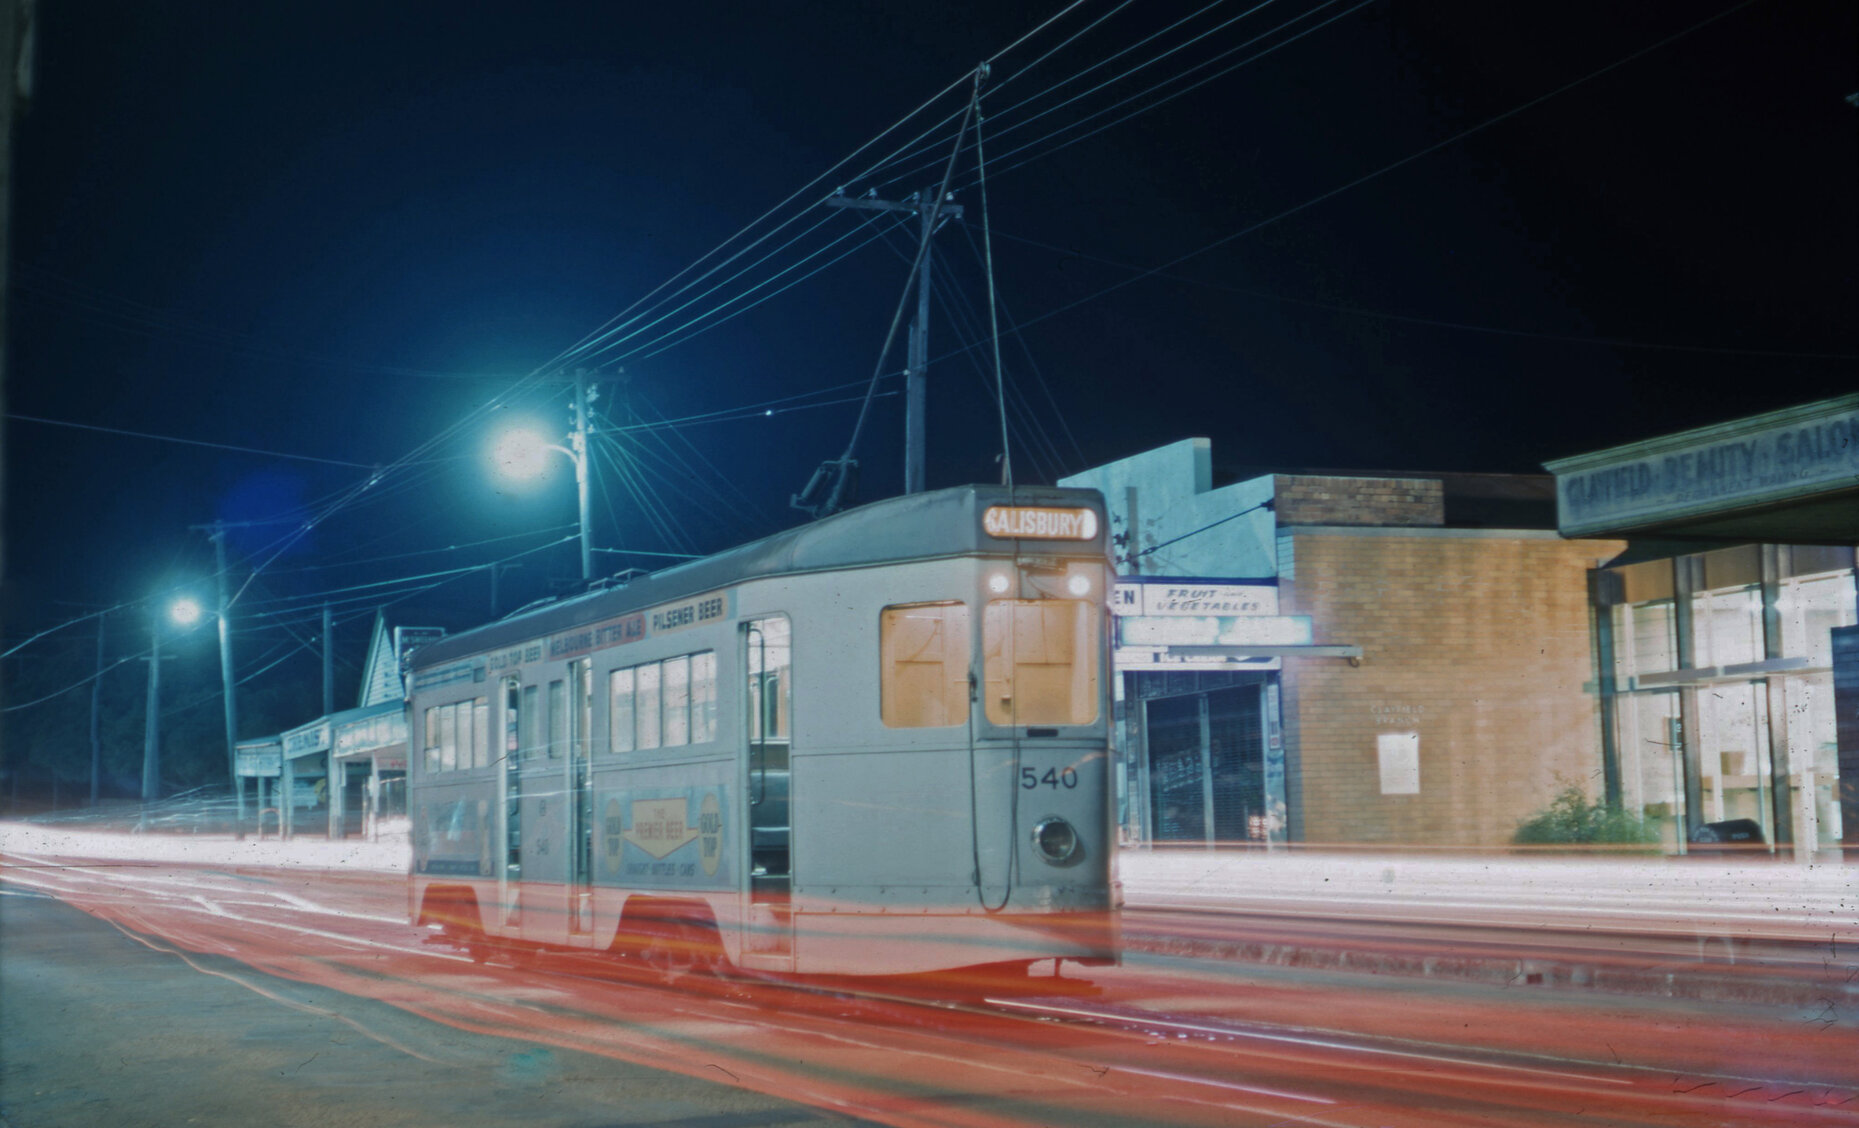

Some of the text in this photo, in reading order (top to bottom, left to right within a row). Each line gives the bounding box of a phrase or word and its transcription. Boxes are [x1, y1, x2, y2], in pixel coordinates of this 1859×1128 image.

[1664, 440, 1756, 494] BEAUTY
[986, 508, 1083, 536] SALISBURY
[1167, 589, 1218, 598] FRUIT
[653, 598, 723, 632] PILSENER BEER
[1157, 601, 1261, 611] VEGETABLES
[596, 623, 622, 645] BITTER
[626, 618, 642, 638] ALE
[525, 646, 541, 663] BEER
[1021, 766, 1078, 790] 540
[666, 820, 684, 840] BEER
[700, 812, 719, 834] GOLD
[703, 836, 717, 858] TOP
